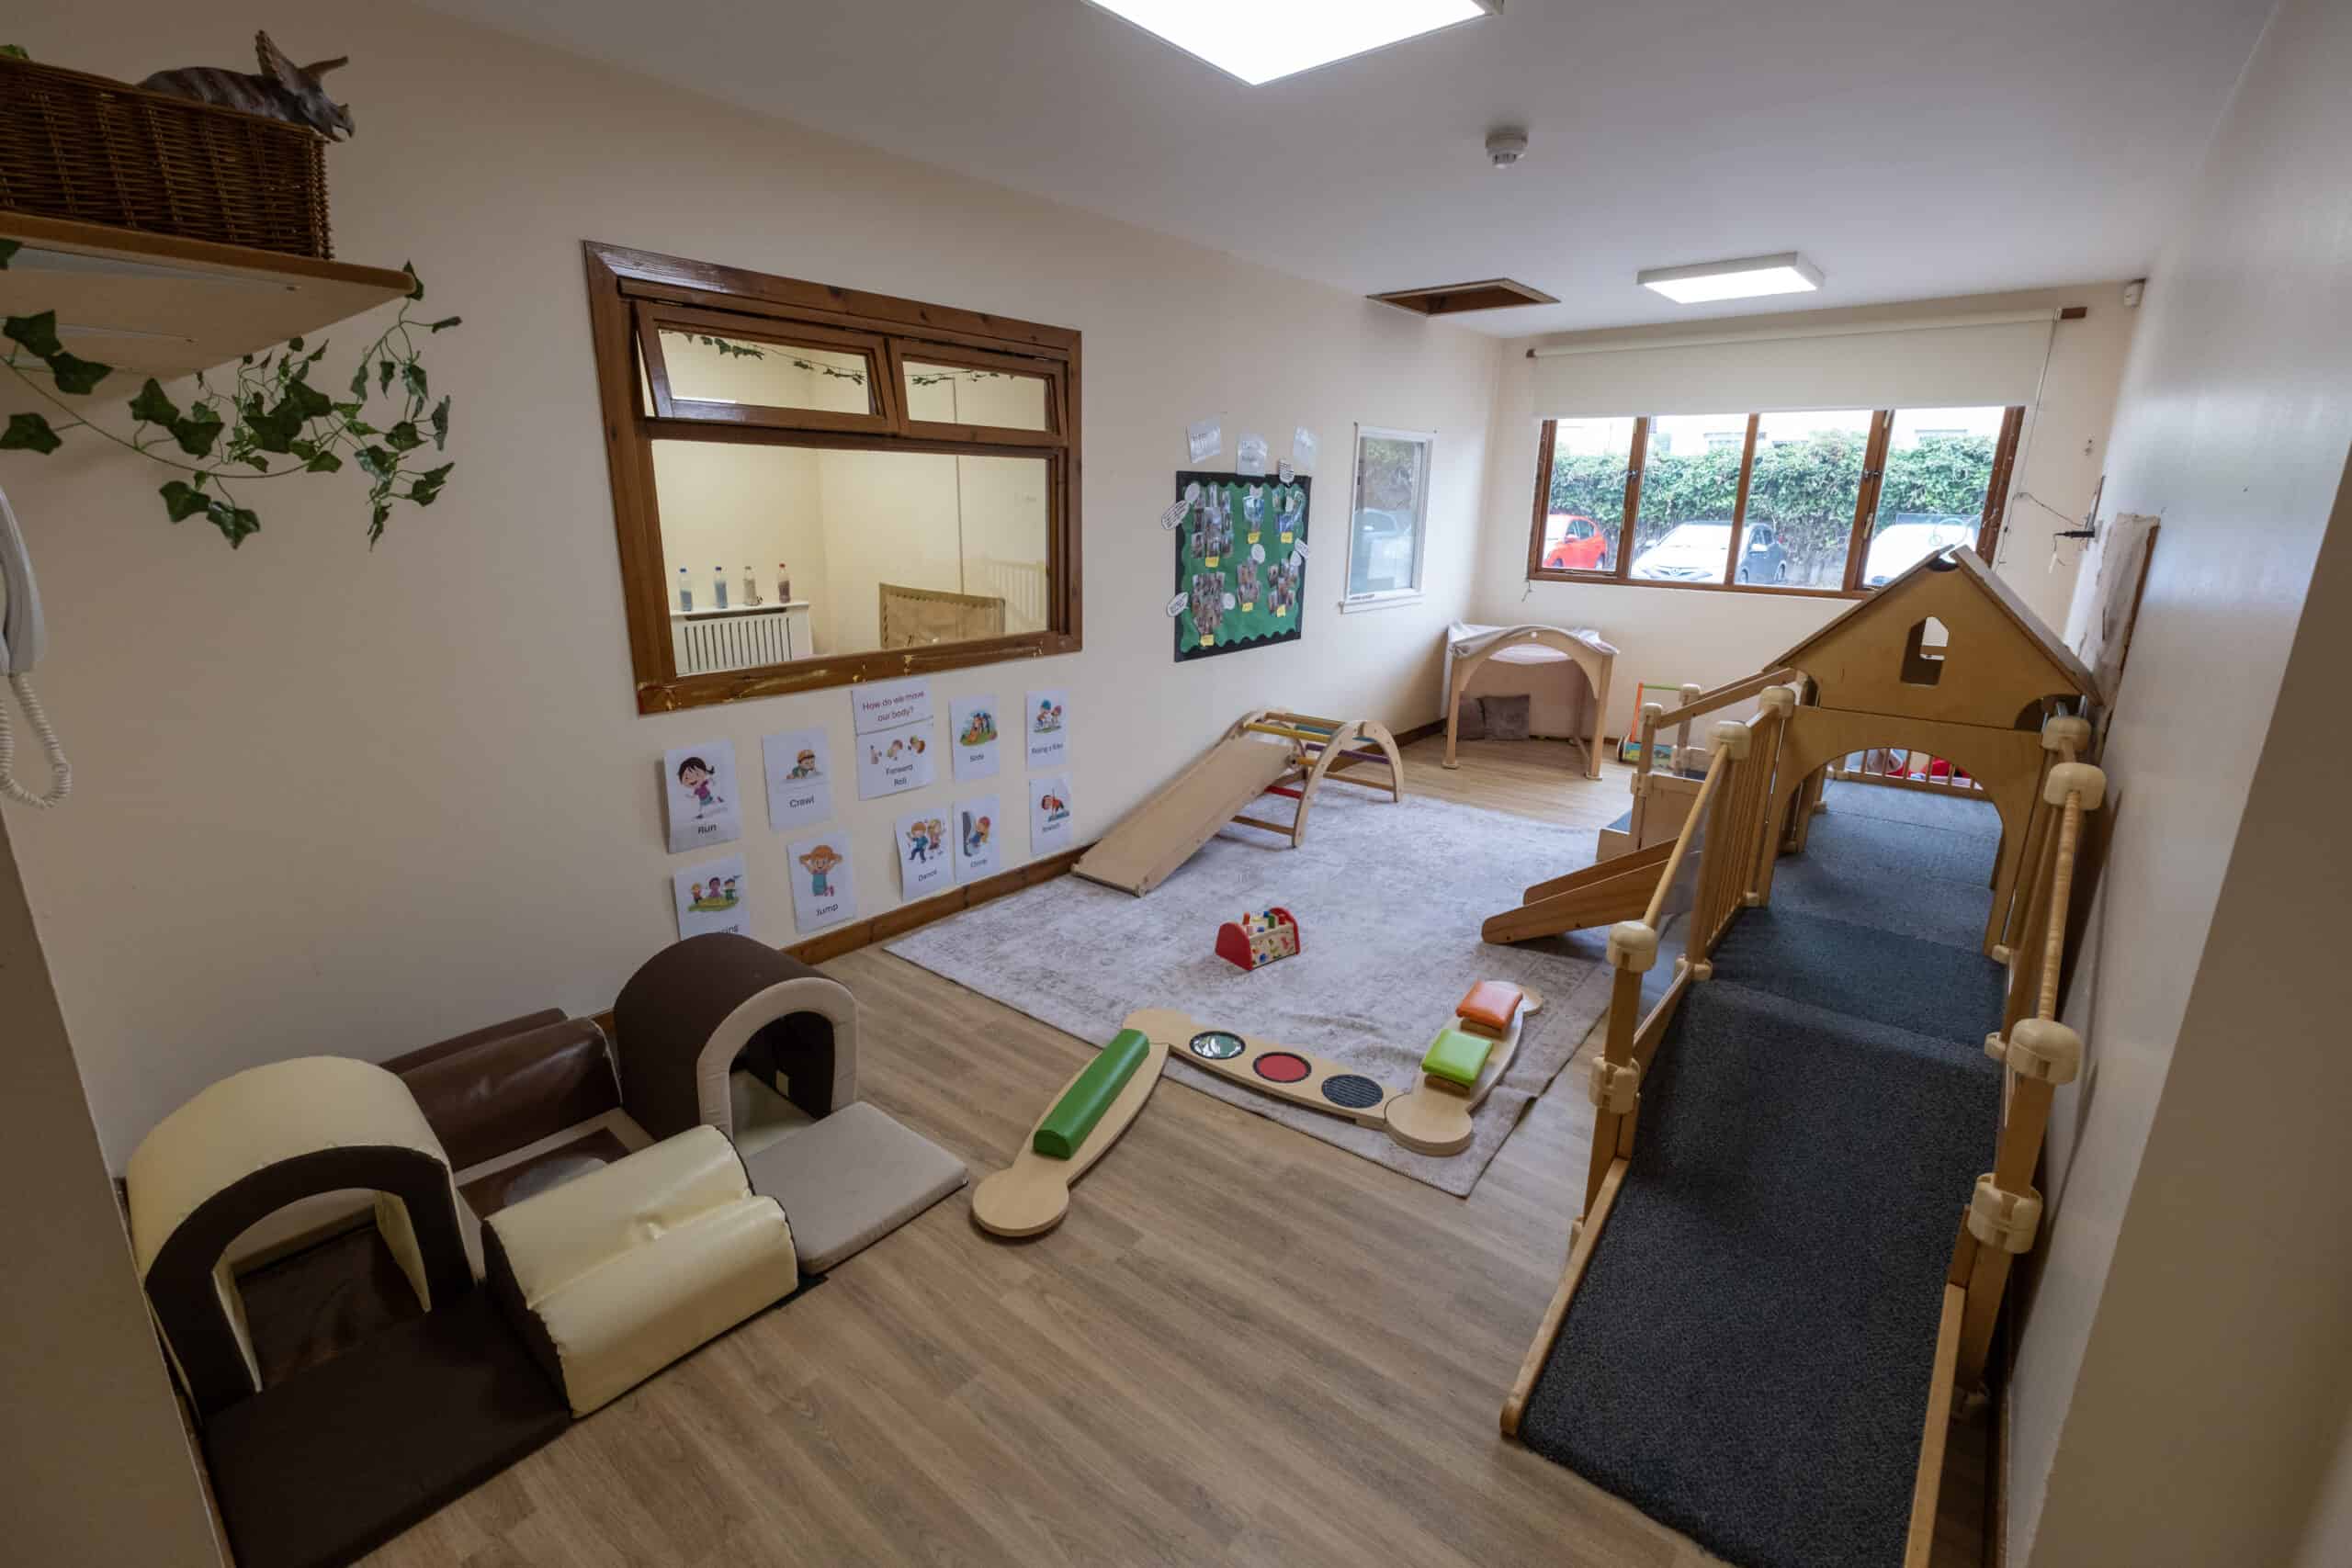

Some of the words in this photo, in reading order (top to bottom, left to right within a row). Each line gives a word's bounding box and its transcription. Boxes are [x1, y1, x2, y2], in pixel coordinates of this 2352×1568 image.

[863, 701, 881, 712] How
[882, 697, 892, 706] do
[893, 695, 904, 705] we
[877, 713, 890, 722] our
[892, 705, 914, 721] body?
[893, 777, 908, 786] Roll
[789, 795, 815, 808] Crawl
[697, 823, 717, 835] Run
[918, 870, 937, 882] Dance
[815, 903, 839, 917] Jump
